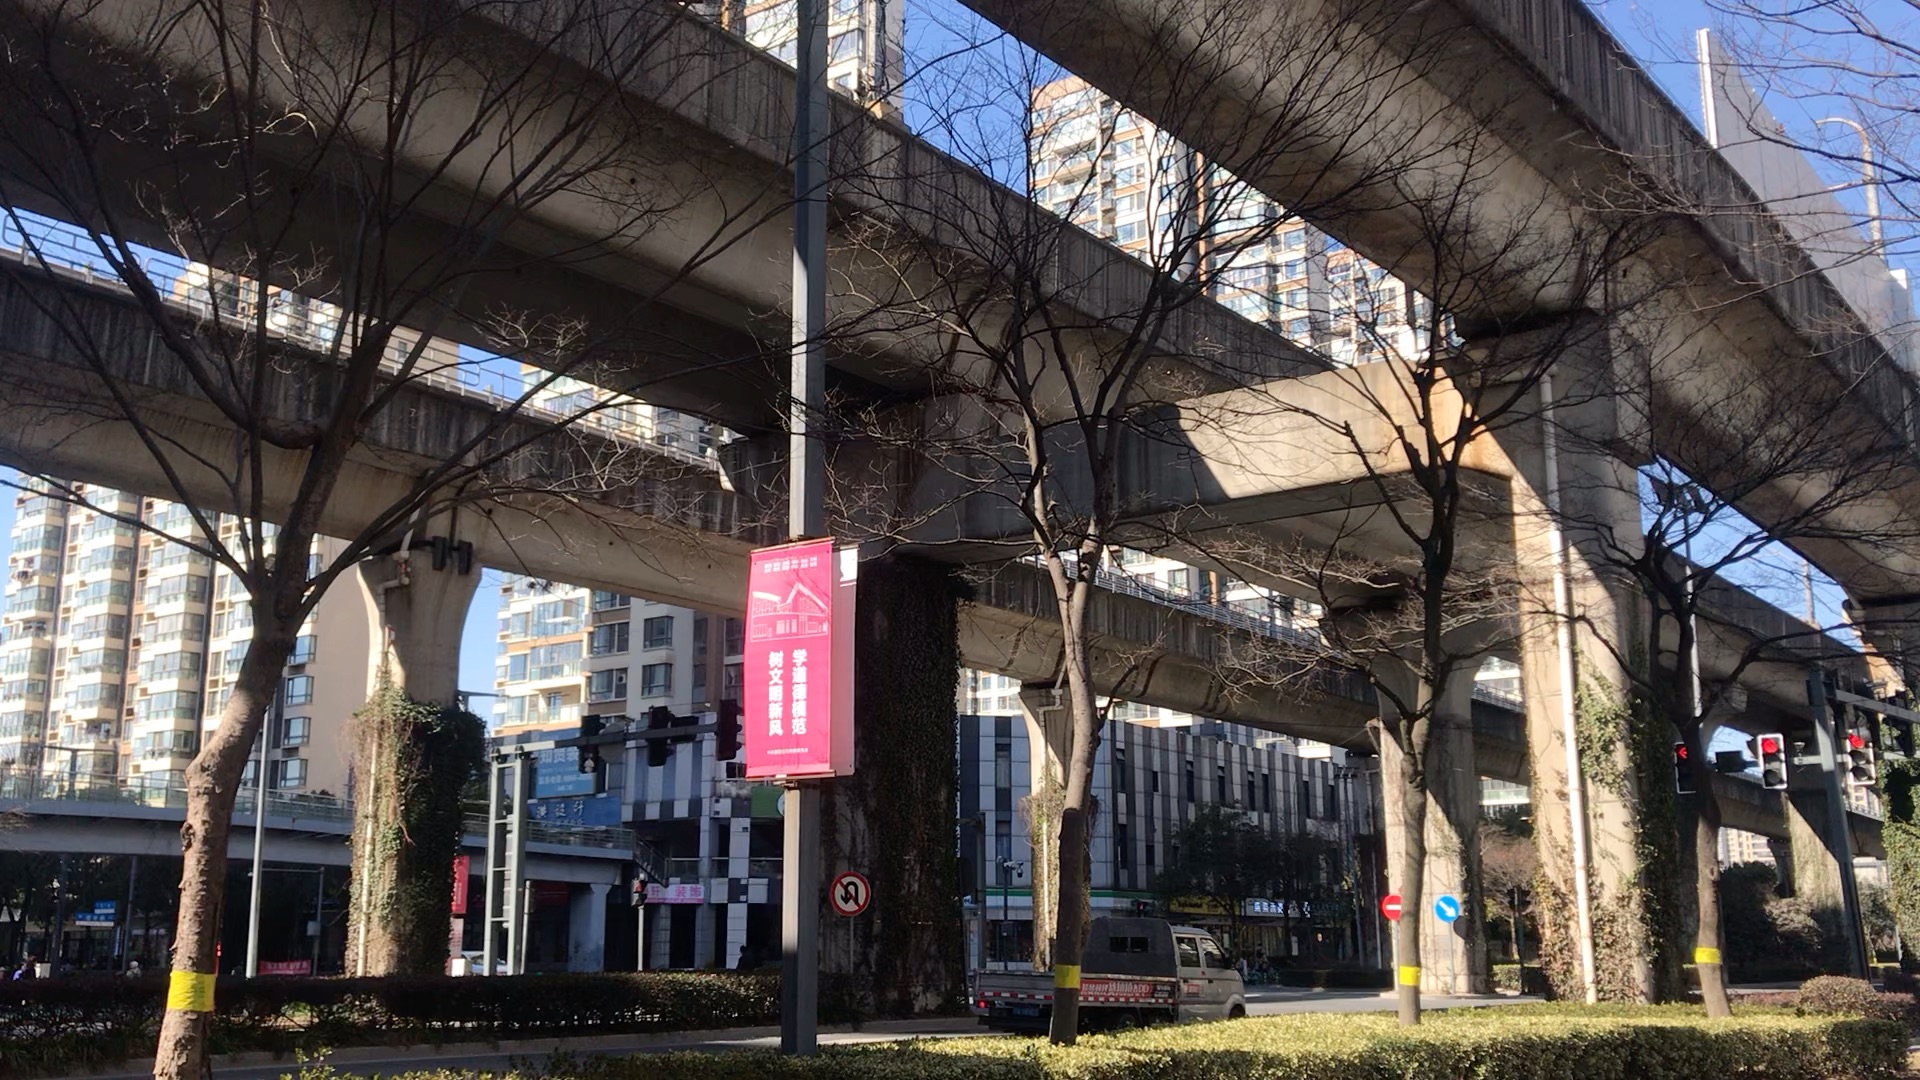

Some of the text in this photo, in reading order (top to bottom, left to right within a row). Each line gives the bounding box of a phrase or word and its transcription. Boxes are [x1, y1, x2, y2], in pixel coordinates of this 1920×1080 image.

[768, 650, 784, 737] 树文明新风
[791, 648, 808, 735] 学道德模范
